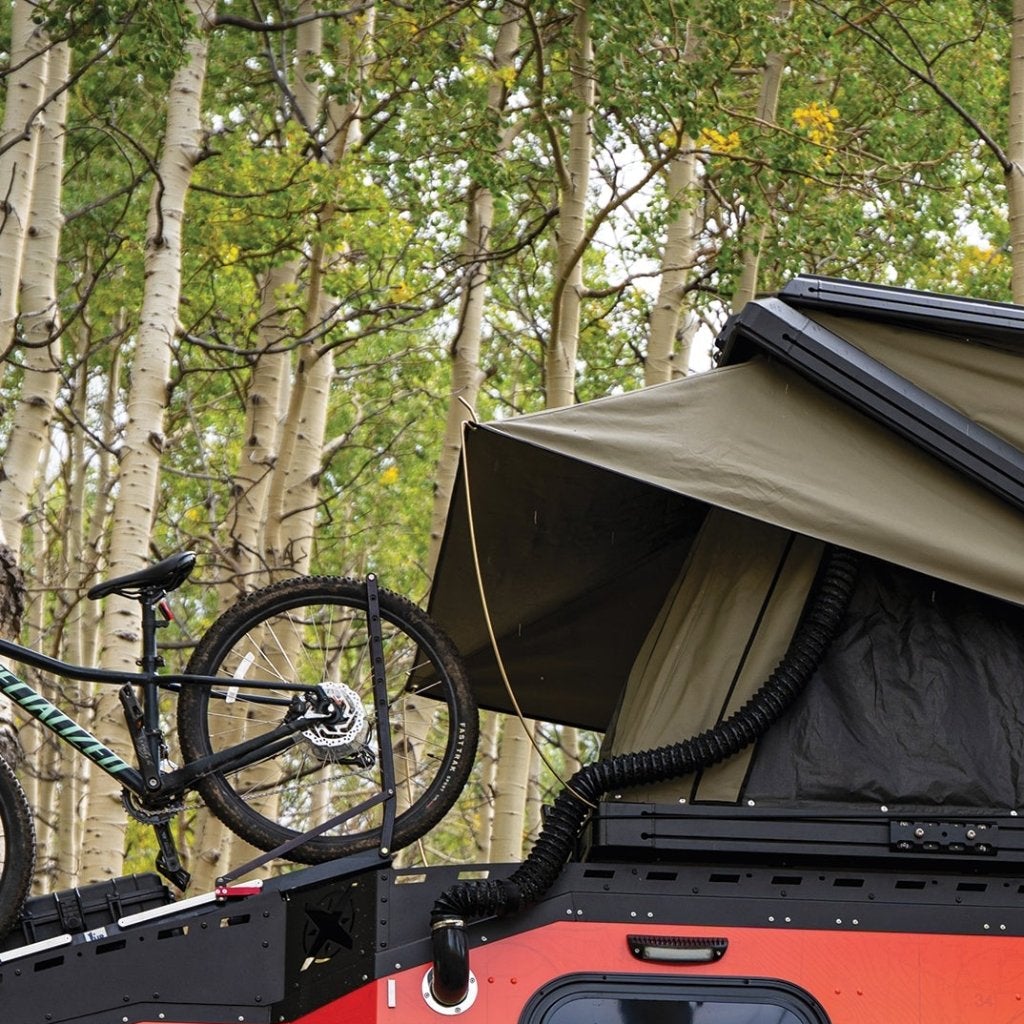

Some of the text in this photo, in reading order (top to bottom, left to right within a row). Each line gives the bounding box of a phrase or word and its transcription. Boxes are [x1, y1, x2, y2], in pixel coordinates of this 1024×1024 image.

[0, 664, 128, 773] ECIALIZED
[457, 722, 466, 746] FAST
[449, 748, 463, 772] TRAK
